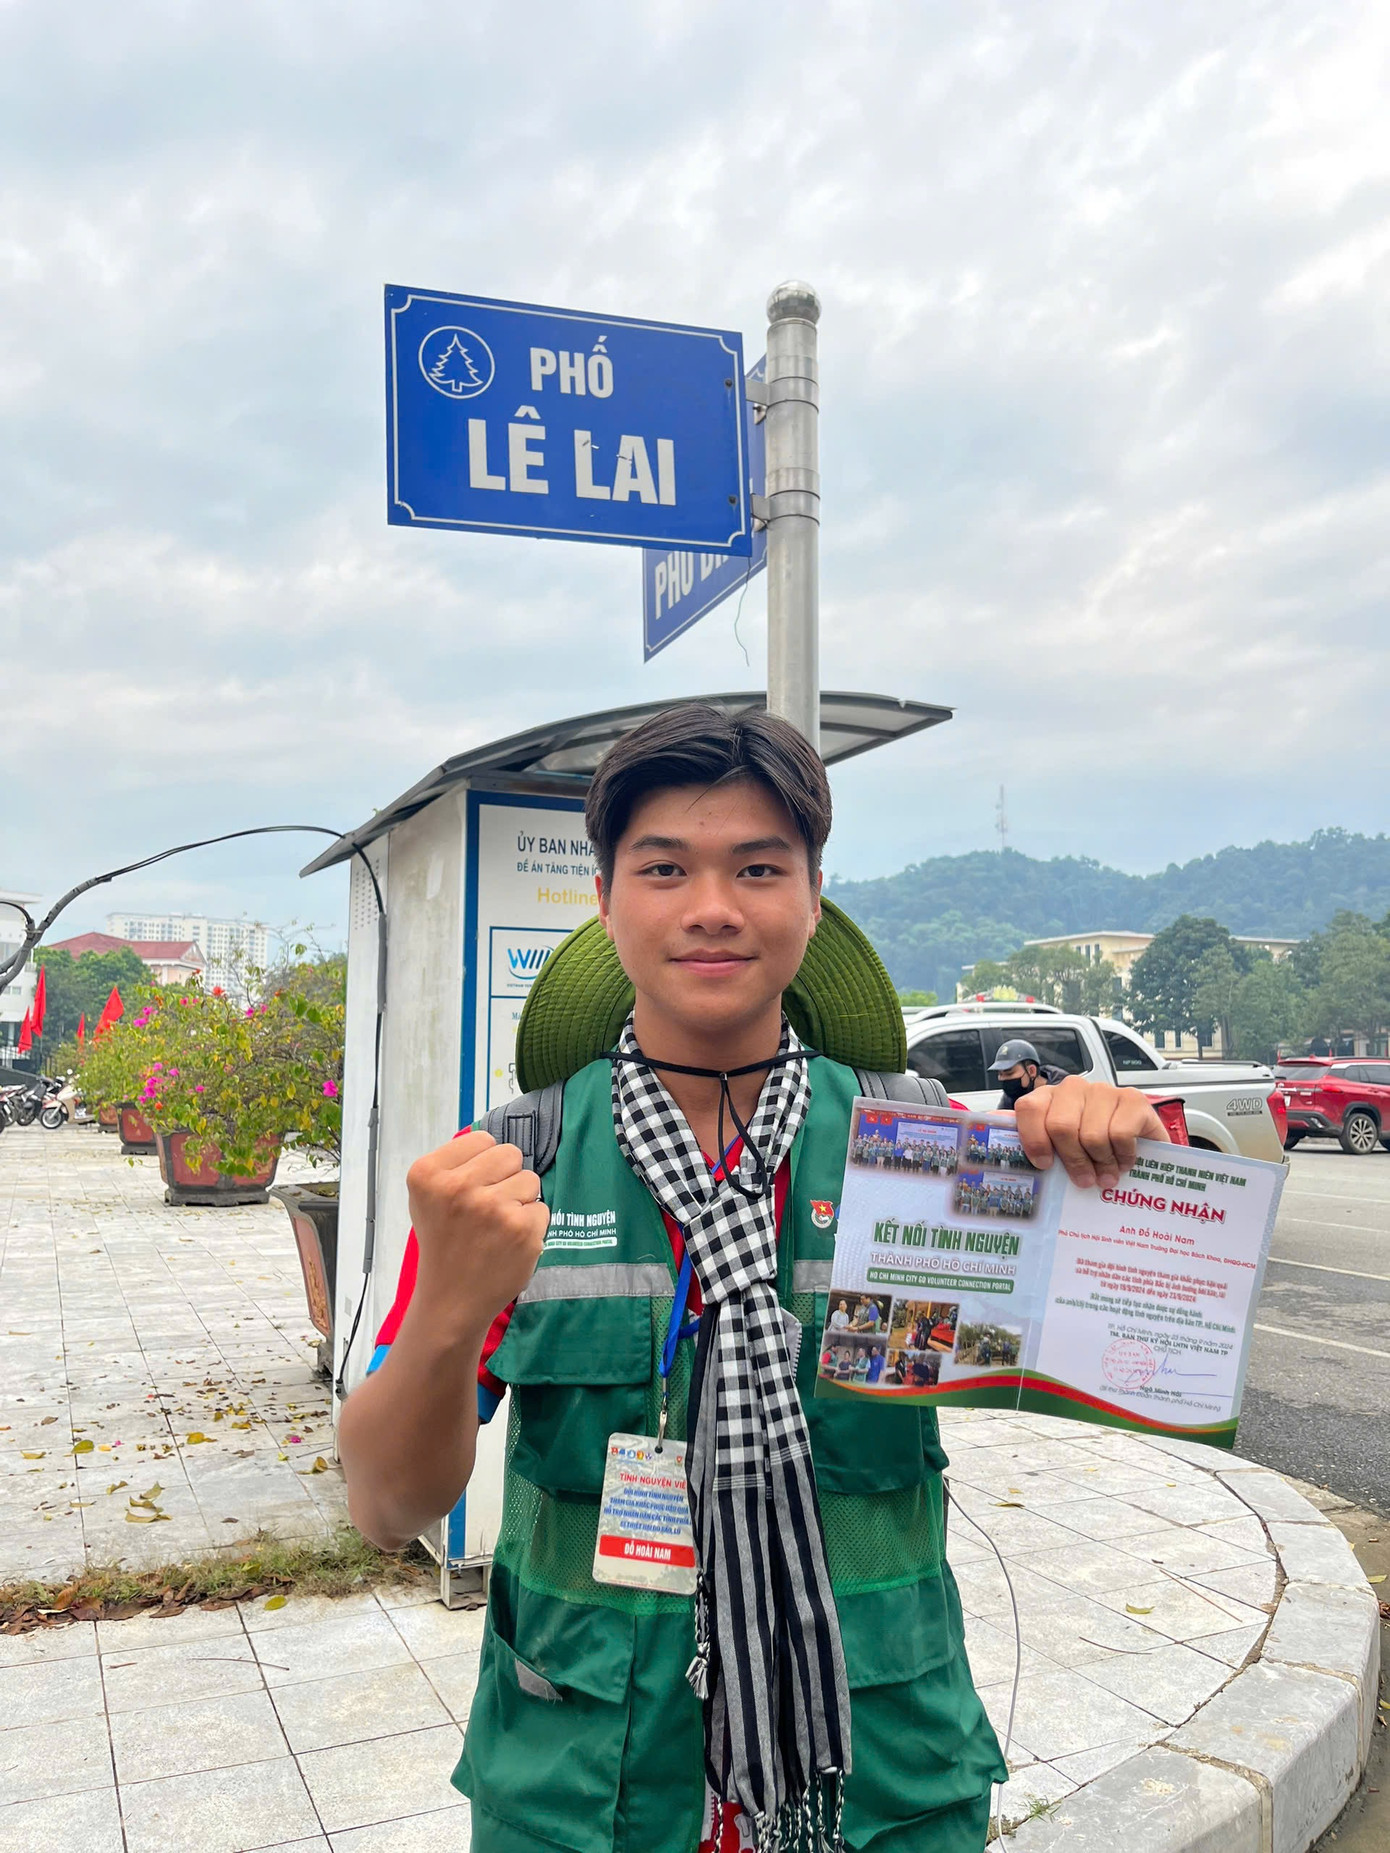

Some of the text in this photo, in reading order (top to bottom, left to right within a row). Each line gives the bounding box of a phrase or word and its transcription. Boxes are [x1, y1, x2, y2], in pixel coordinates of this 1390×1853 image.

[530, 336, 614, 398] PHỐ
[468, 405, 676, 506] LÊ LAI
[517, 830, 536, 852] ỦY
[539, 838, 566, 855] BAN
[531, 860, 543, 873] ÁN
[537, 887, 598, 906] Hotline
[1226, 1098, 1263, 1111] 4WD
[1101, 1188, 1225, 1224] CHỨNG NHẬN
[551, 1209, 616, 1227] NỐI TÌNH NGUYỆN
[600, 1228, 617, 1236] MINH
[874, 1218, 1020, 1259] KẾT NỐI TÌNH NGUYỆN
[1120, 1225, 1194, 1244] Anh Đỗ Hoài Nam
[872, 1250, 912, 1266] THÀNH
[984, 1263, 1016, 1276] MINH
[890, 1273, 905, 1281] MINH
[906, 1274, 918, 1282] CITY
[928, 1276, 957, 1286] VOLUNTEER
[958, 1279, 991, 1289] CONNECTION
[992, 1282, 1010, 1291] PORTAL
[620, 1472, 637, 1482] TÌNH
[640, 1474, 671, 1488] NGUYỆN
[624, 1540, 671, 1561] ĐỖ HOÀI NAM
